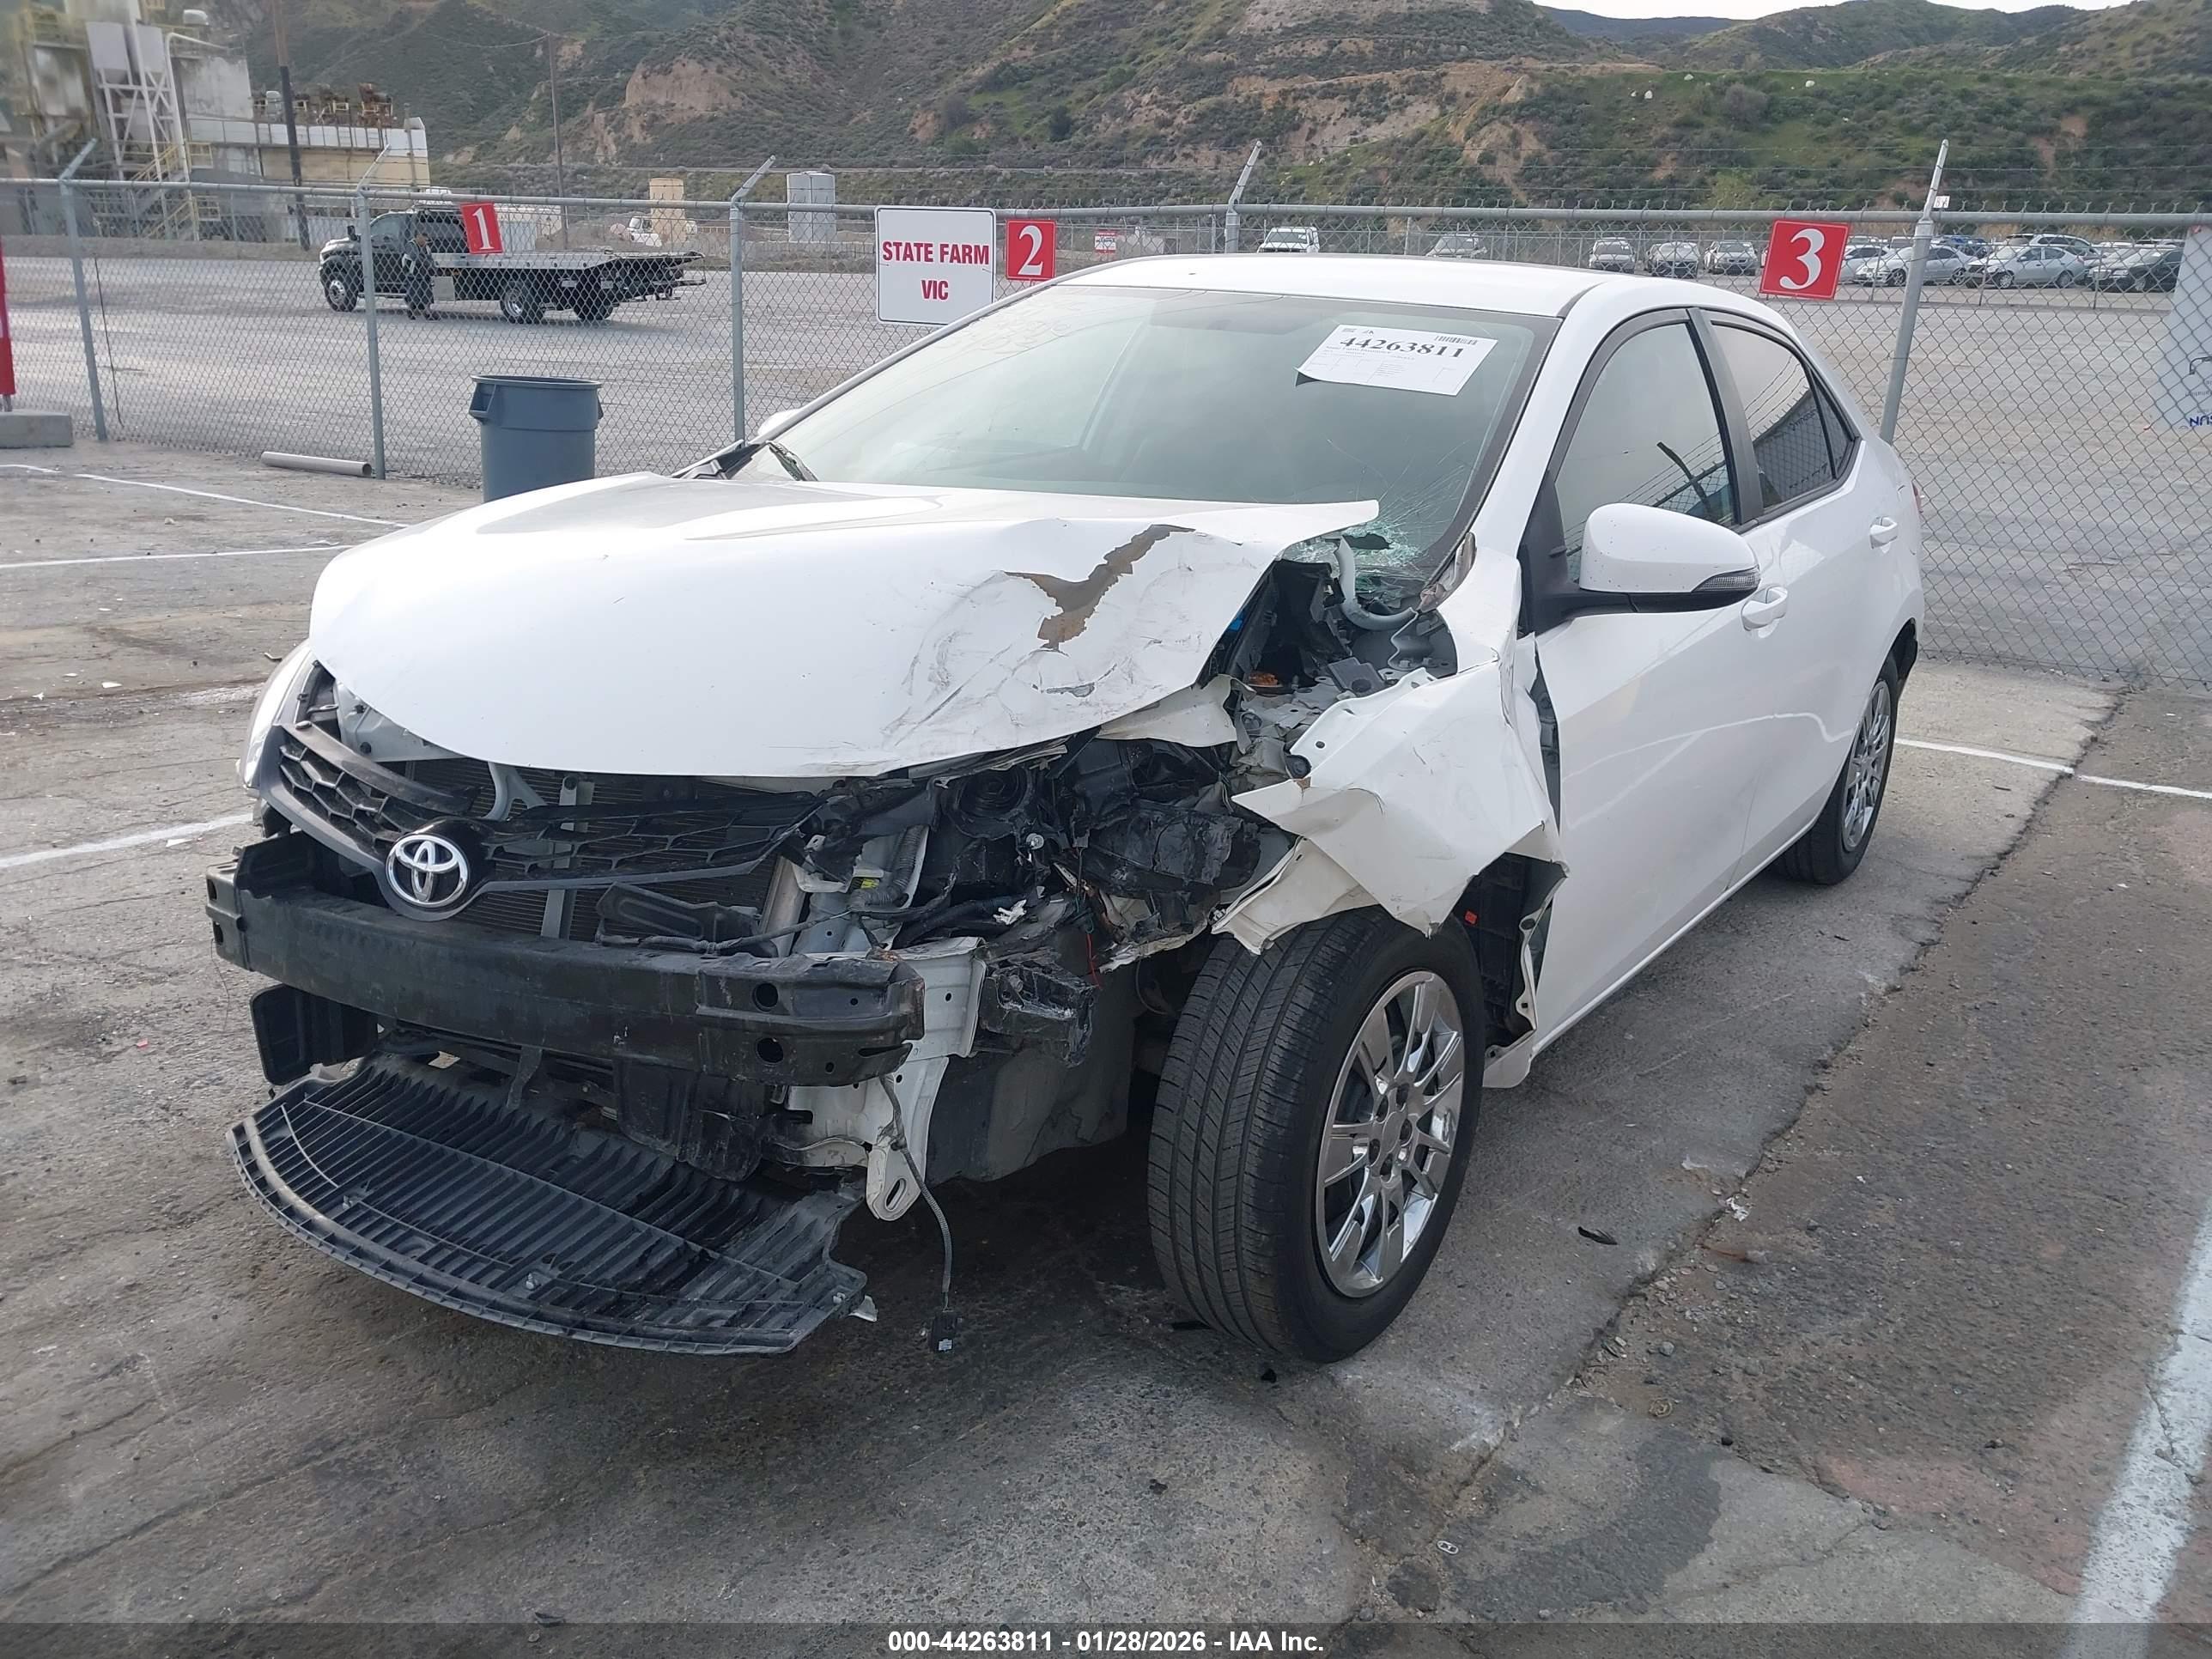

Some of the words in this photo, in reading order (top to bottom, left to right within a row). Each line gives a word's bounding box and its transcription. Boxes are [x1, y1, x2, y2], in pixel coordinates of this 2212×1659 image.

[471, 207, 495, 250] 1
[882, 240, 934, 263] STATE
[939, 243, 990, 265] FARM
[1018, 224, 1043, 276] 2
[1779, 228, 1825, 289] 3
[921, 279, 949, 301] VIC
[1340, 337, 1464, 358] 44263811
